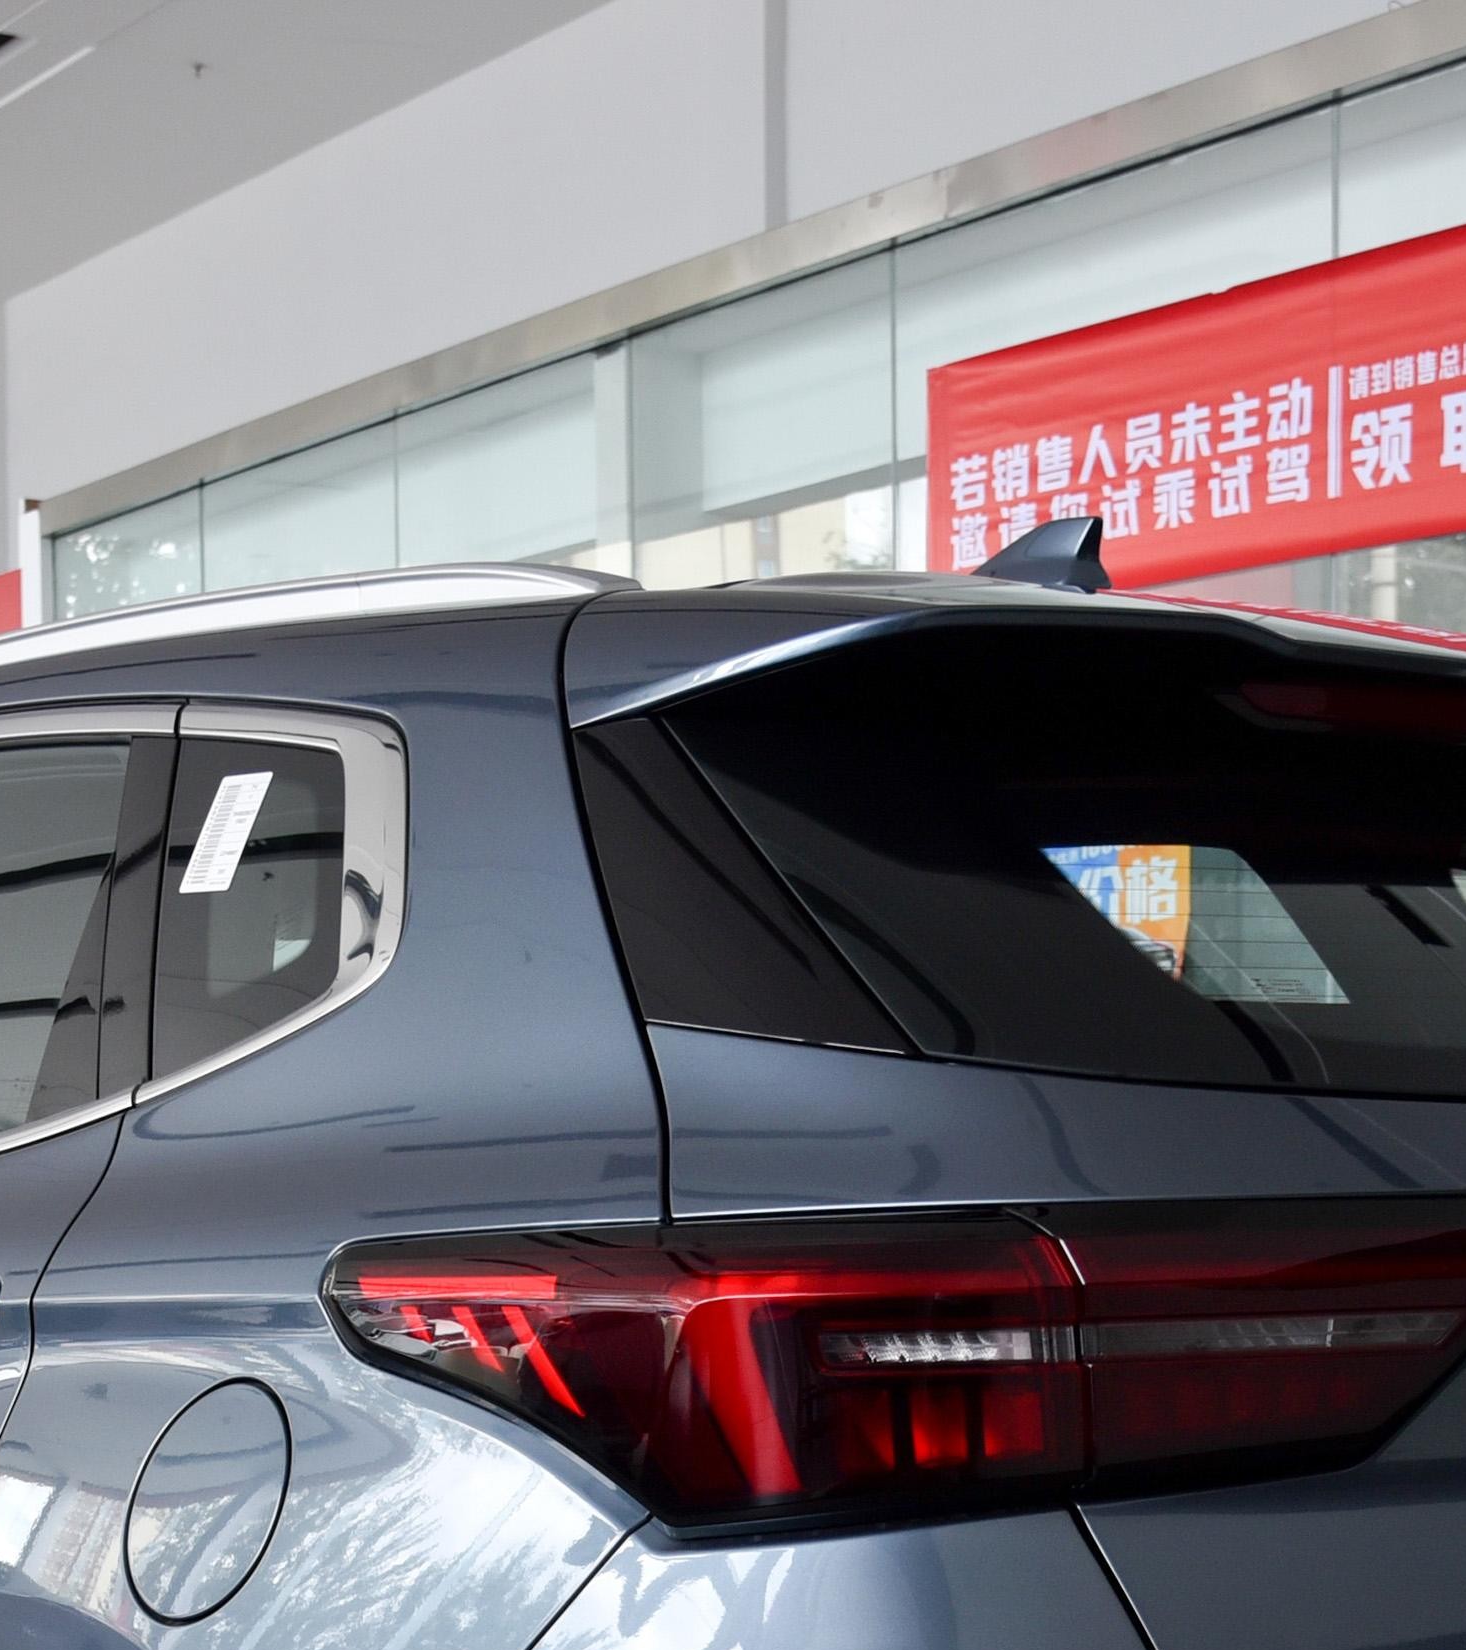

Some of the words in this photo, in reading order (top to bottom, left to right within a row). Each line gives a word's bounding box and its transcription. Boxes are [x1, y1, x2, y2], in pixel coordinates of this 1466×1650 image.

[950, 377, 1314, 511] 若销售人员未主动
